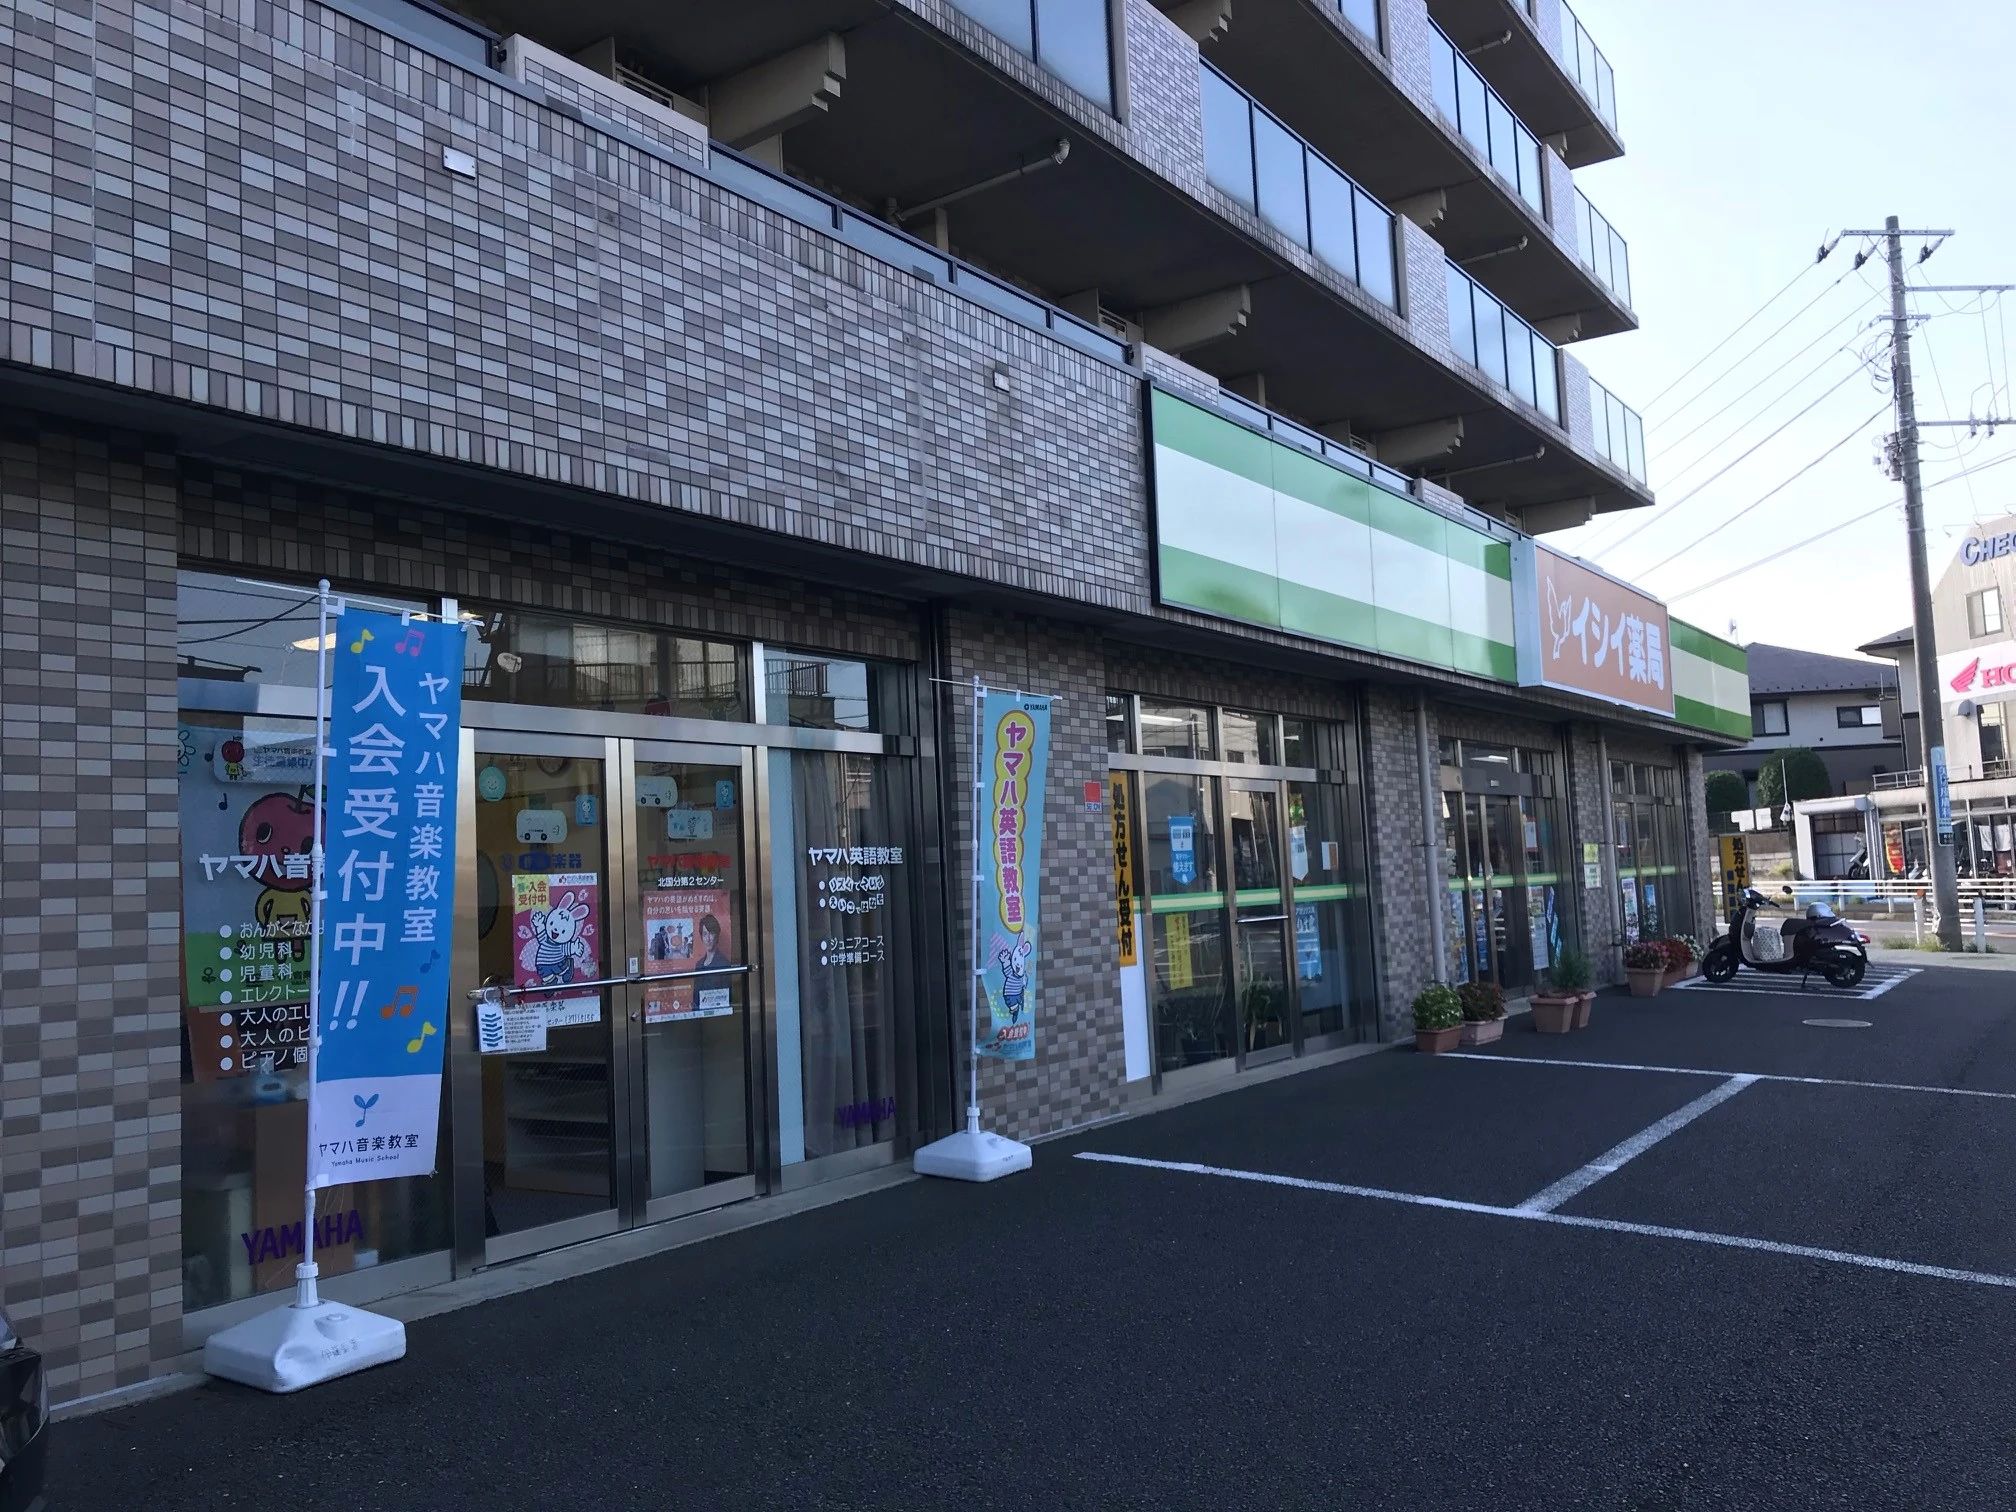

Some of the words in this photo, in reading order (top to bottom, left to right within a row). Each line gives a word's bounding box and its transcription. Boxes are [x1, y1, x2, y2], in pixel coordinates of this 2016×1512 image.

[1572, 596, 1665, 691] イシイ薬局
[399, 672, 450, 944] ヤマハ音楽教室
[998, 721, 1027, 923] ヤマハ英語教室
[808, 846, 904, 866] ヤマハ英語教室
[518, 894, 547, 906] 受付中
[239, 942, 293, 960] 幼児科
[830, 935, 885, 951] ジュニアコース
[830, 950, 885, 966] 中学準備コース
[240, 963, 293, 982] 児童科
[240, 984, 320, 1003] エレクトー
[318, 1133, 419, 1157] ヤマハ音楽教室
[331, 1159, 353, 1167] Yamaha
[355, 1156, 375, 1164] Music
[376, 1153, 400, 1162] School
